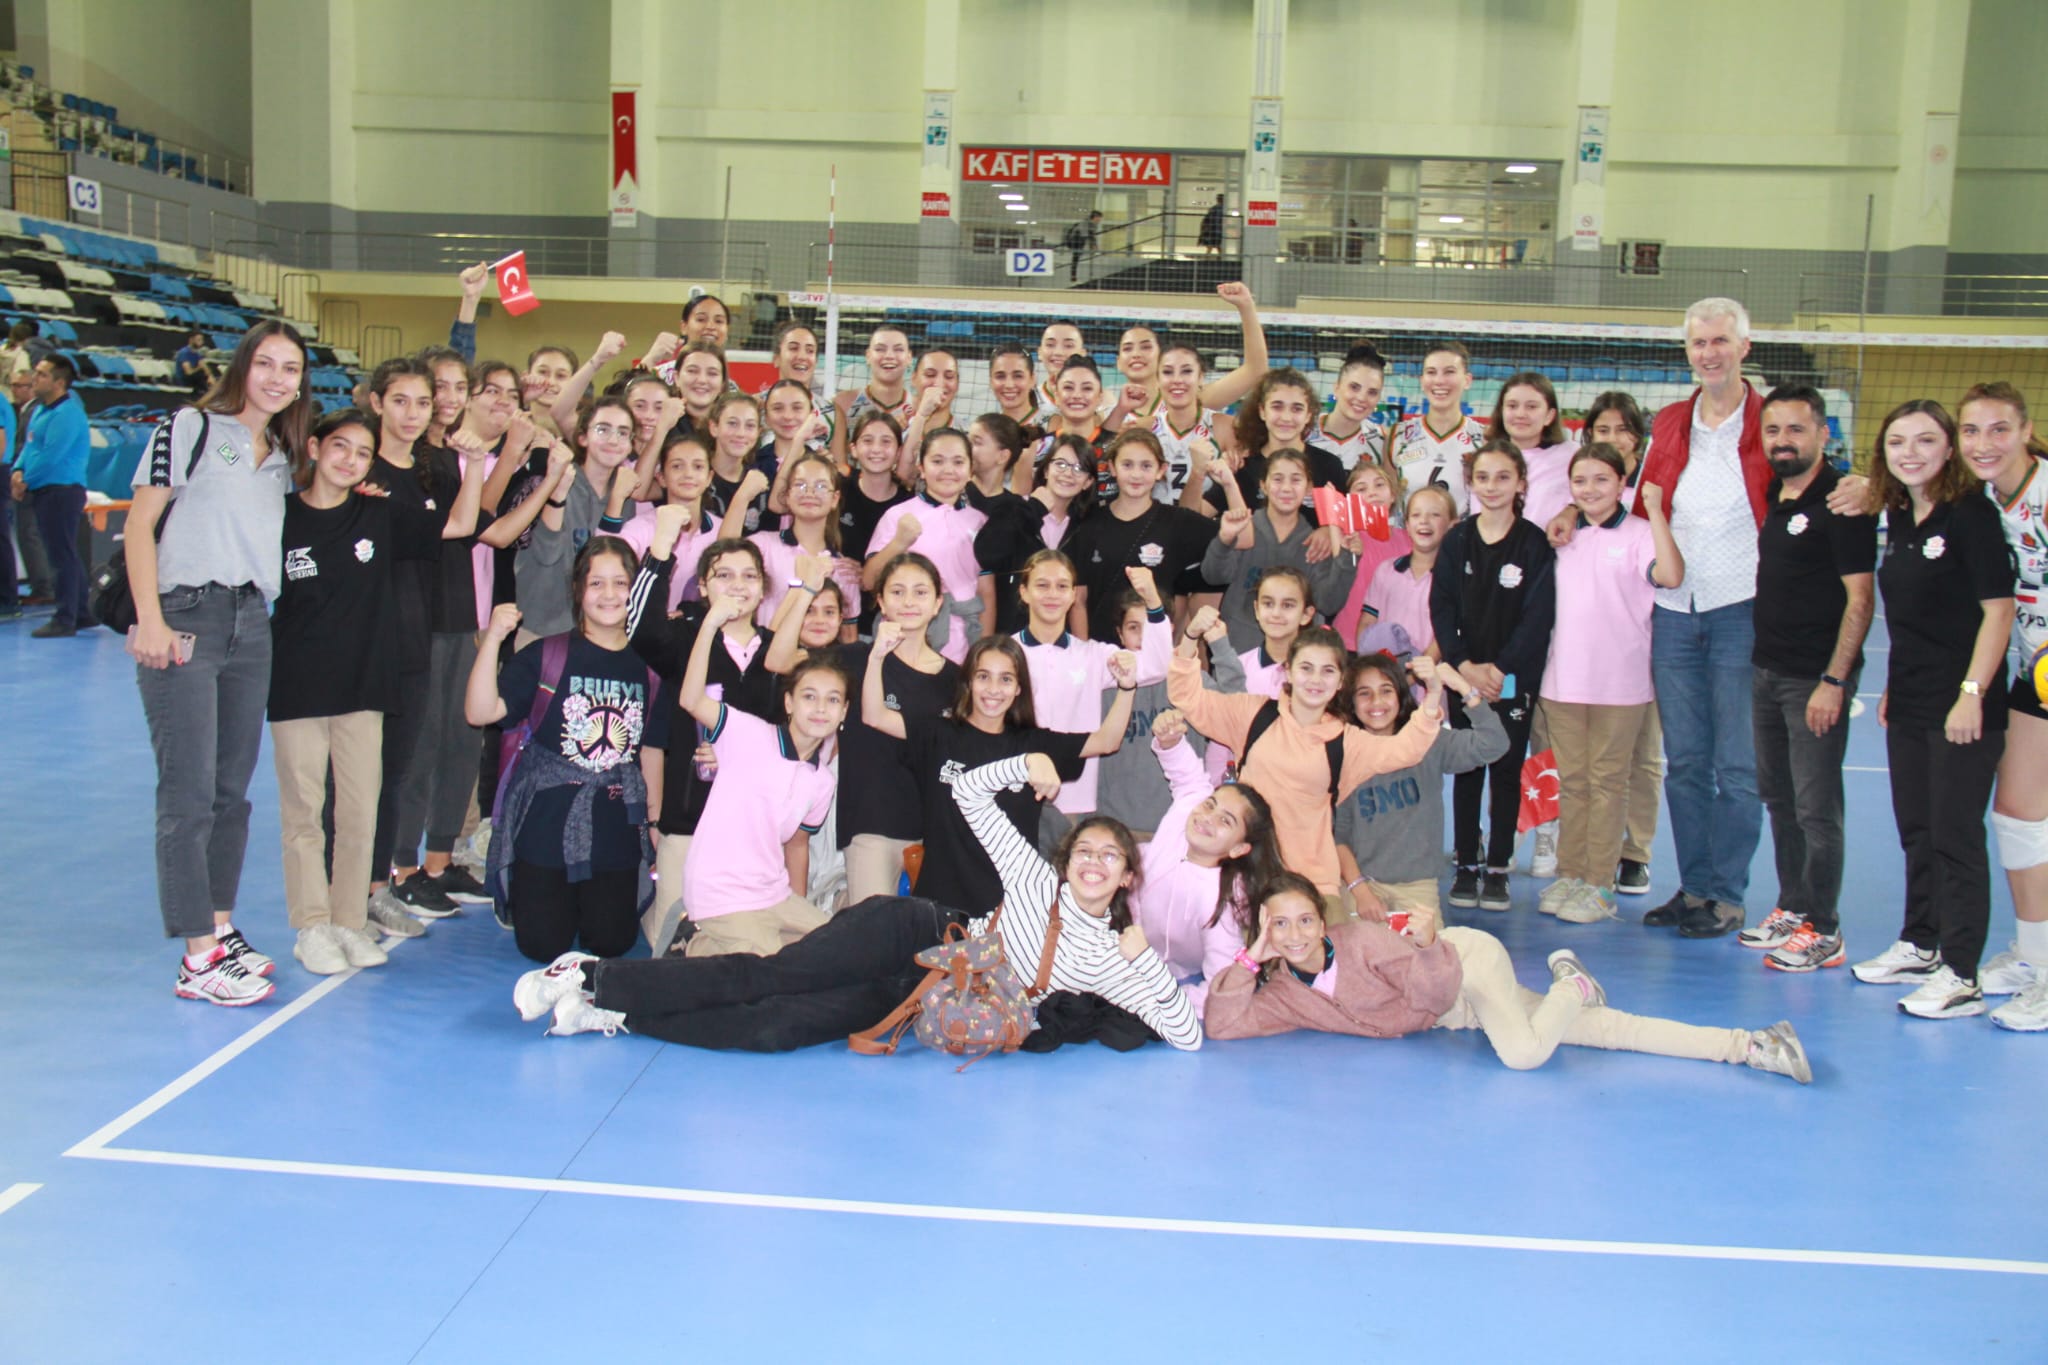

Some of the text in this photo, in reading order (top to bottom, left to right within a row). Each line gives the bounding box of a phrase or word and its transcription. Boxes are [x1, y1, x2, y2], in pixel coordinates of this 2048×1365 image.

[967, 152, 1163, 181] KAFETERYA
[75, 182, 97, 209] C3
[1013, 253, 1047, 272] D2
[1358, 776, 1421, 824] ŞMO
